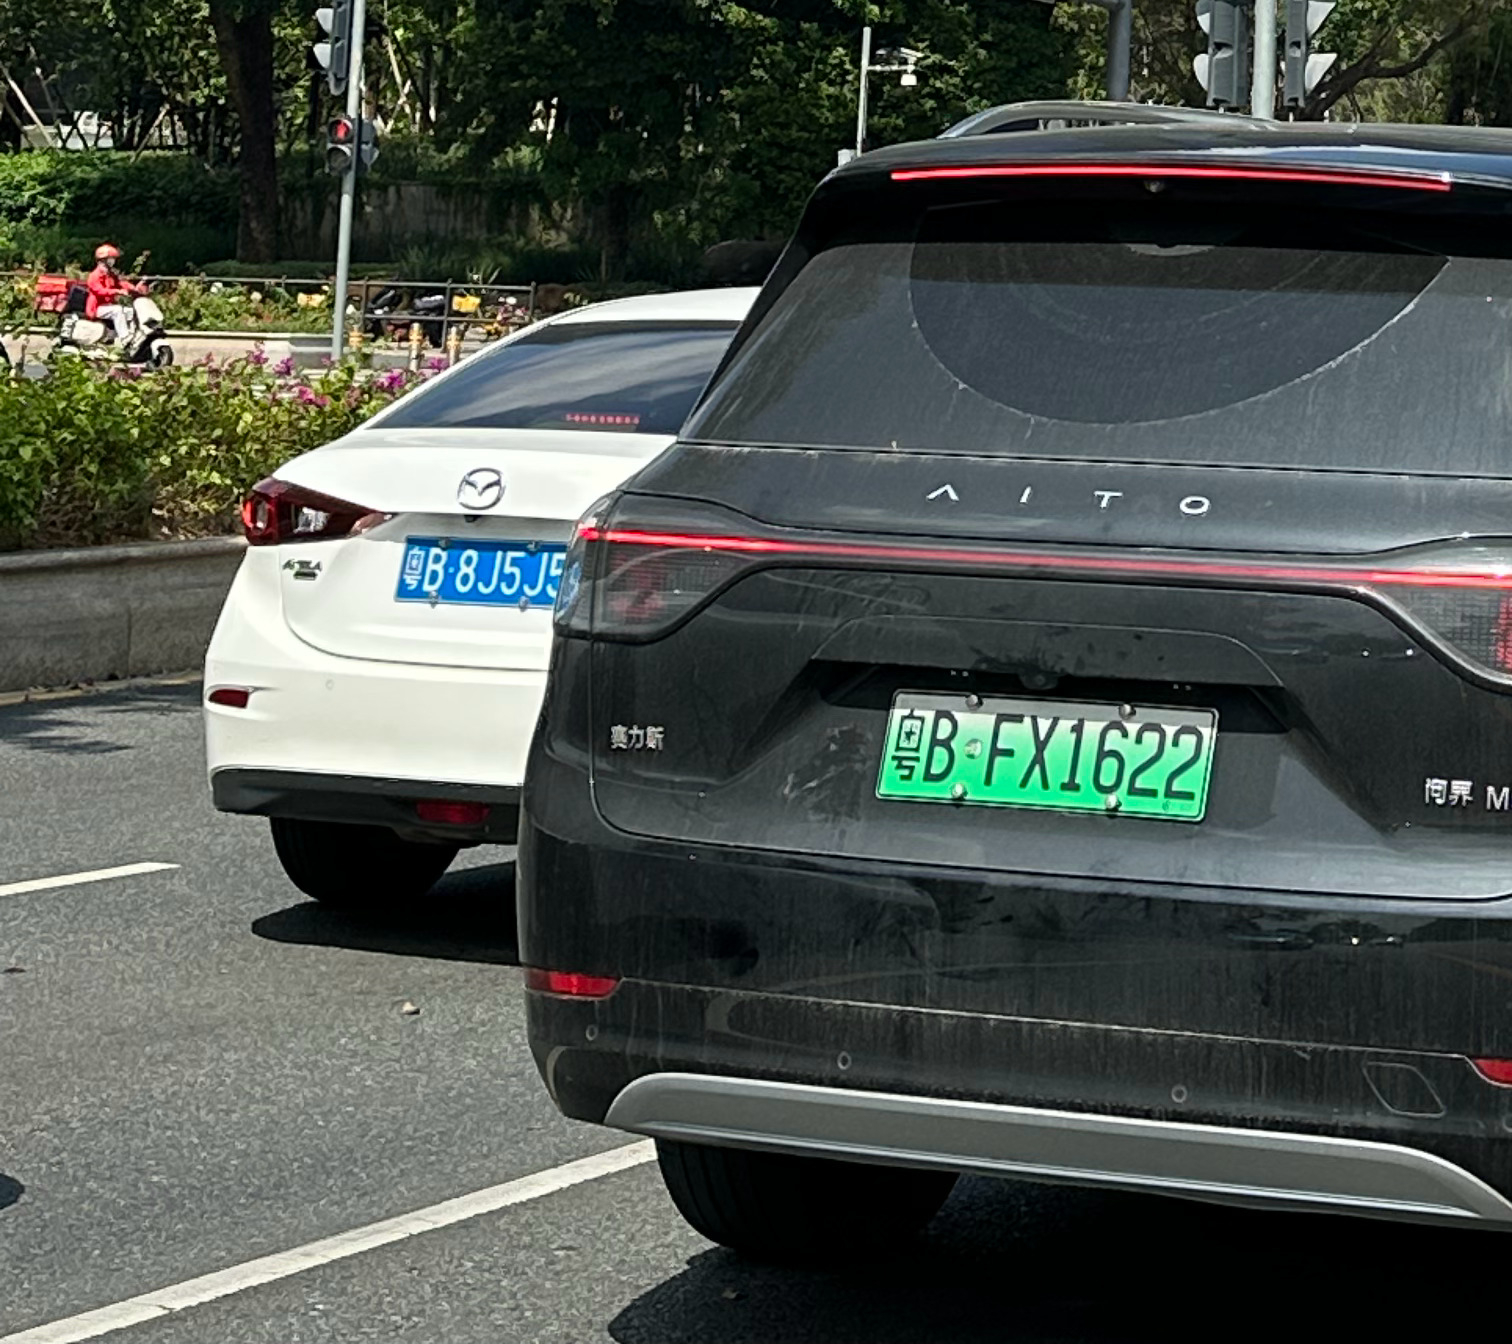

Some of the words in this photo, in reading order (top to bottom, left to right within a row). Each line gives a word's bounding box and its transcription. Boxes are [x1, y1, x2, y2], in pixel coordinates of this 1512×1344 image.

[926, 484, 1210, 515] AITO
[610, 724, 665, 750] 赛力斯
[1425, 777, 1474, 807] 问界
